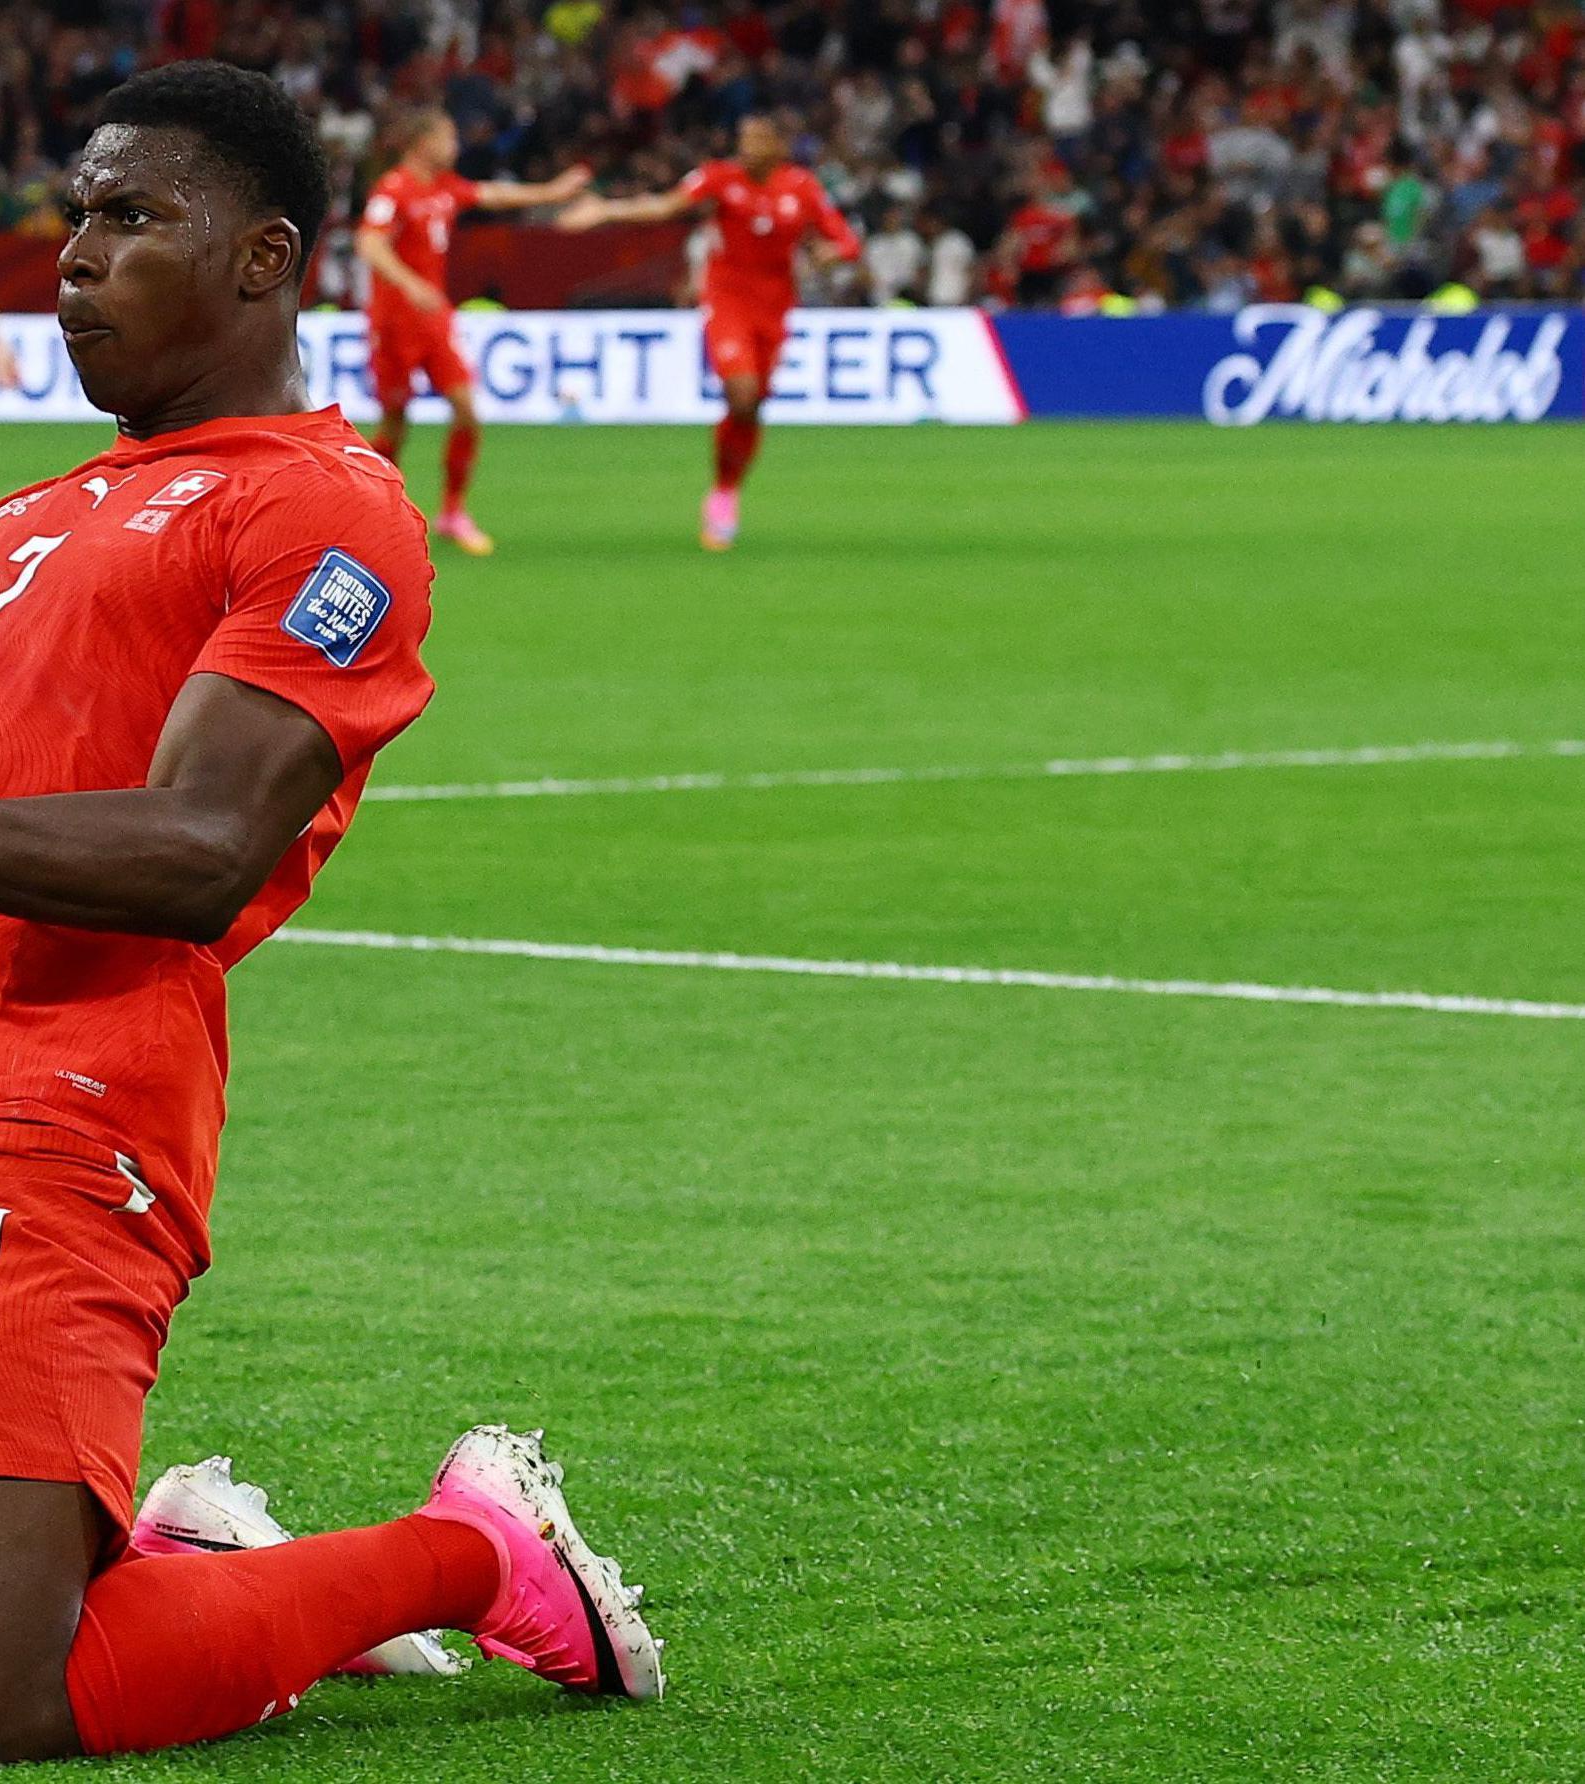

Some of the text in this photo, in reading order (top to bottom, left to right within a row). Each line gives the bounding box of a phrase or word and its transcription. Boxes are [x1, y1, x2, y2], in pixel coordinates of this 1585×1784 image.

[1202, 303, 1568, 418] Michelob
[320, 579, 371, 627] UNITES
[330, 566, 377, 611] FOOTBALL
[306, 598, 363, 645] the World
[314, 622, 337, 641] FIFA
